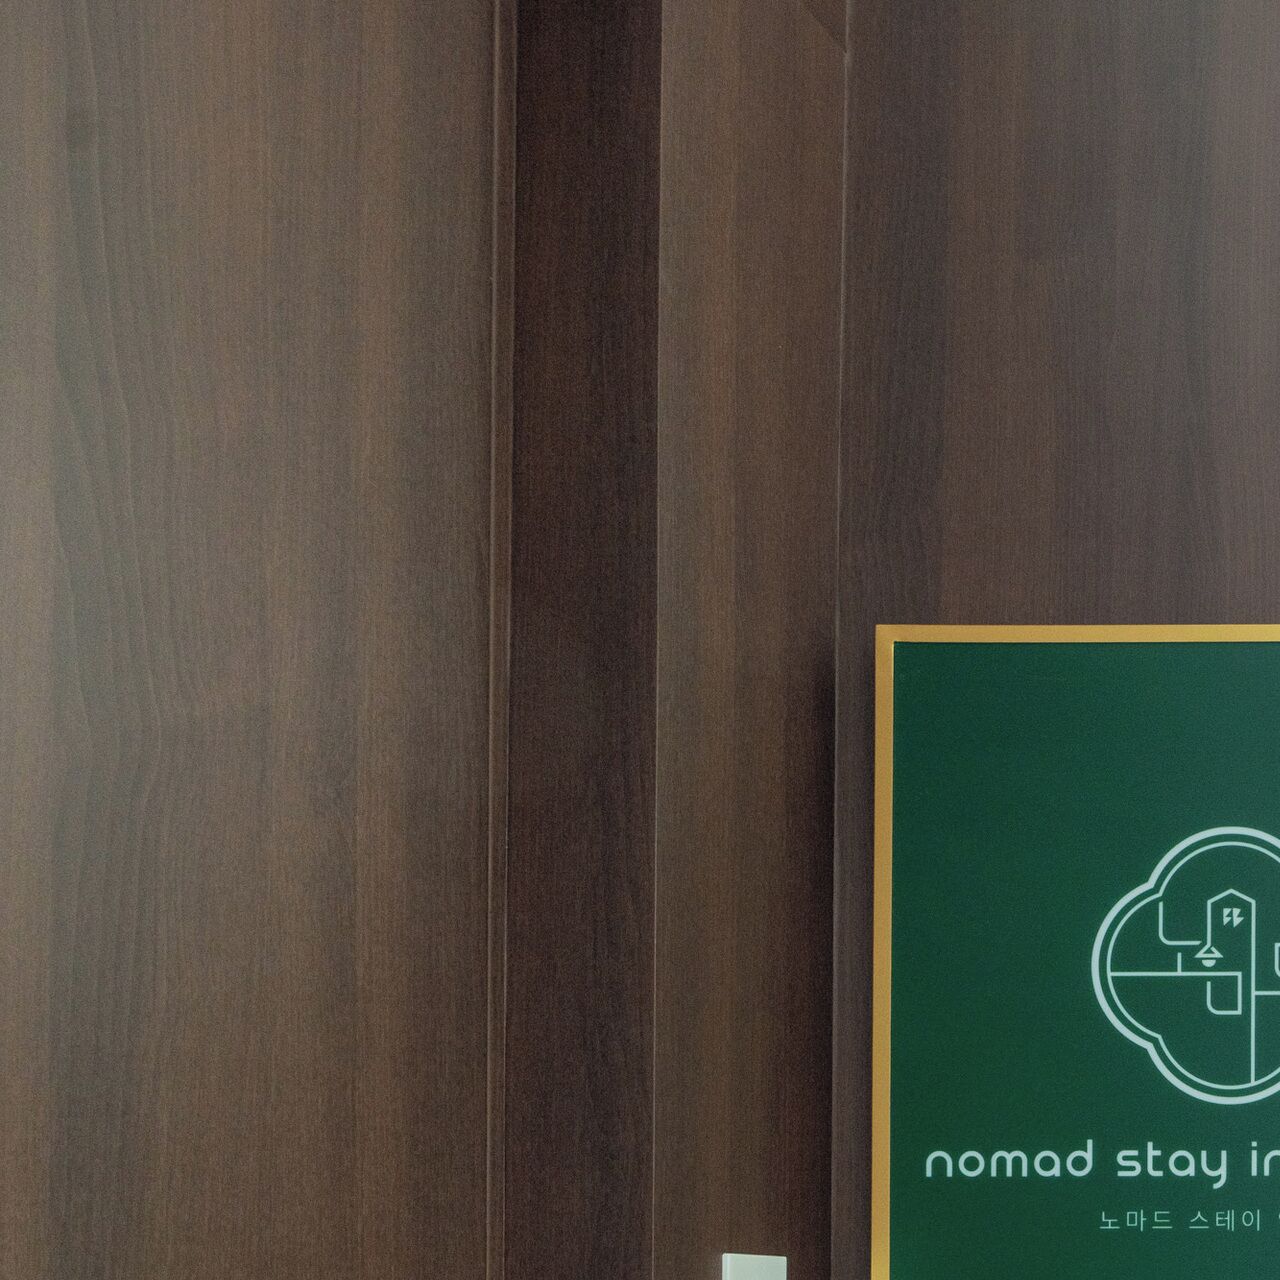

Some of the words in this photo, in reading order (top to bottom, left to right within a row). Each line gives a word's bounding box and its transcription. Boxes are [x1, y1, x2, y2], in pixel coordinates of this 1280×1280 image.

[926, 1139, 1093, 1177] nomad
[1117, 1142, 1227, 1189] stay
[1100, 1210, 1172, 1231] 노마드
[1189, 1209, 1259, 1231] 스테이
